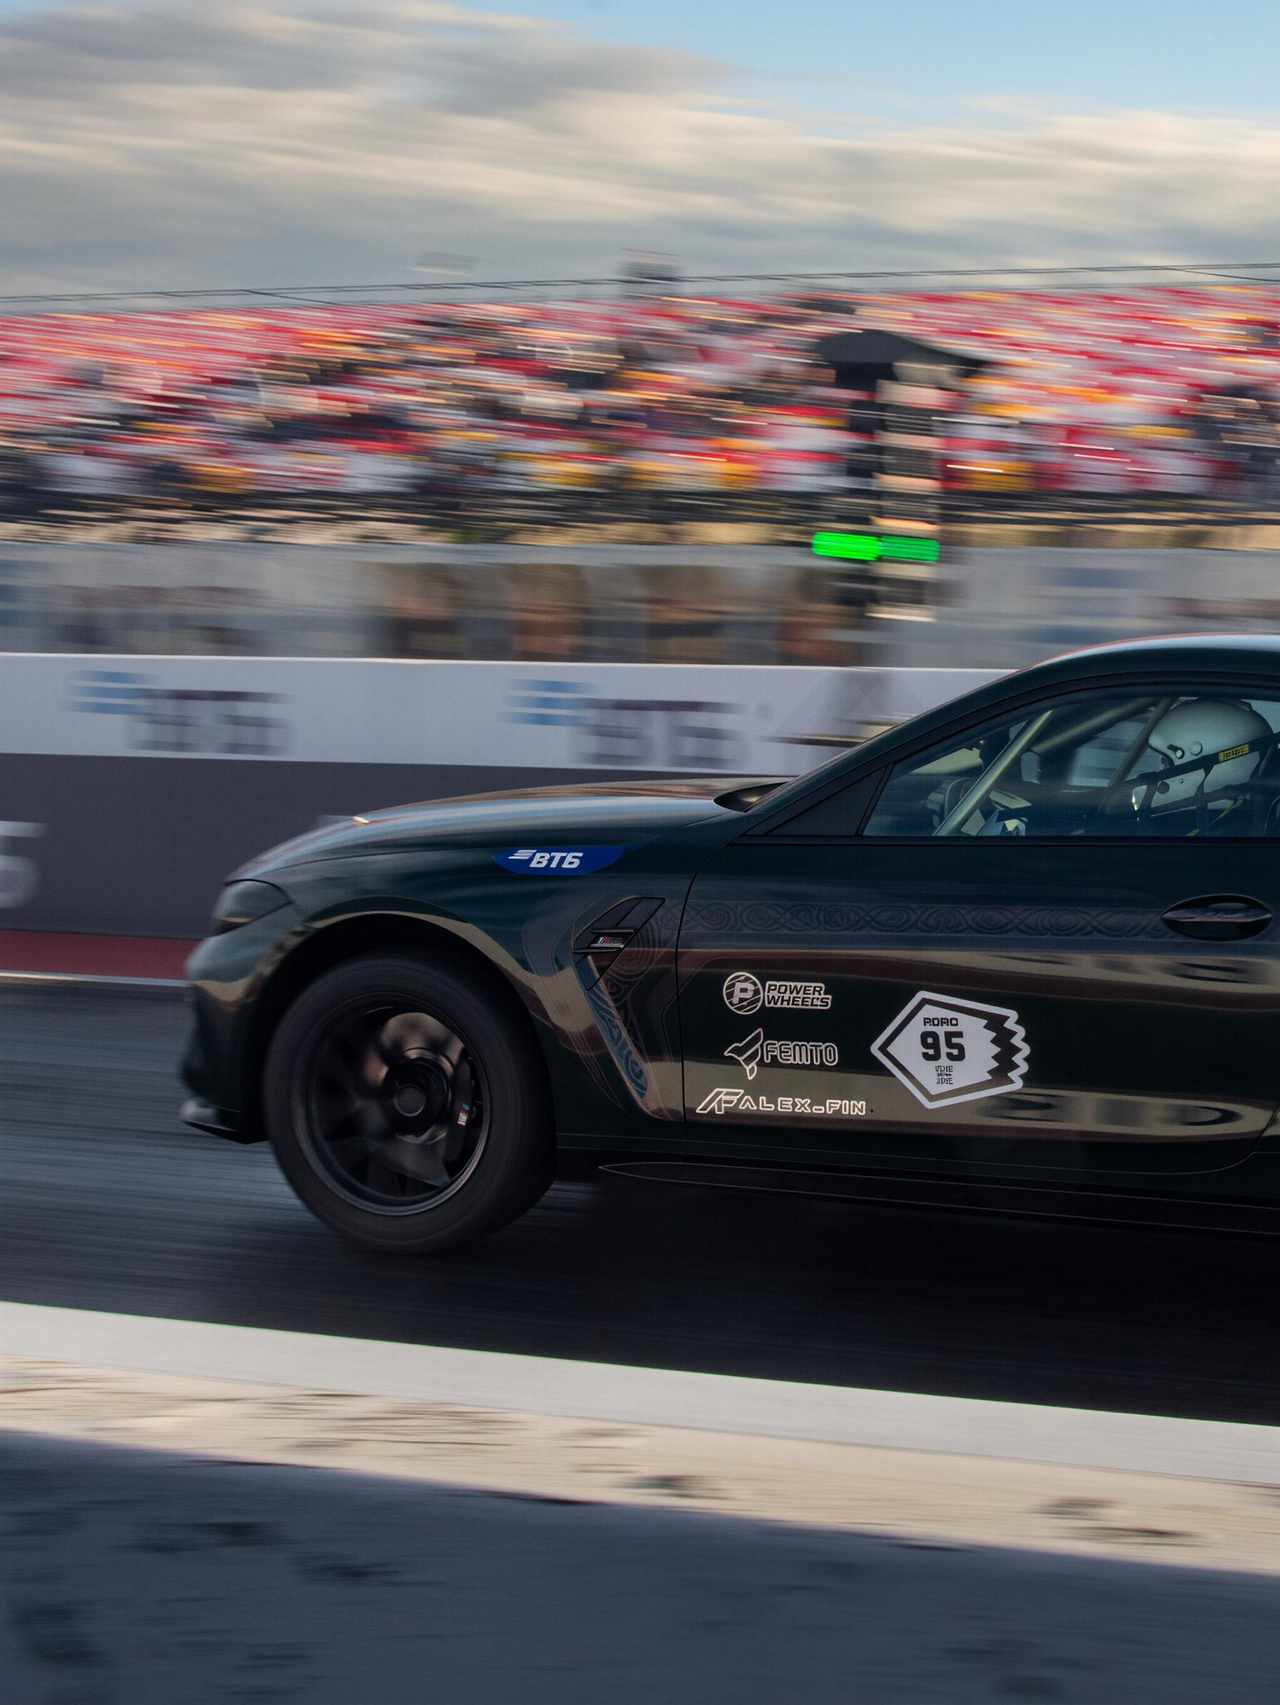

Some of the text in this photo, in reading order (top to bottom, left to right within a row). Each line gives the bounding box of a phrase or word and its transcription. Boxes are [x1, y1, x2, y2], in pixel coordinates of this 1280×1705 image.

[529, 852, 584, 869] ВТБ
[767, 983, 824, 996] POWER
[763, 1041, 839, 1066] FEMTO
[920, 1030, 966, 1062] 95
